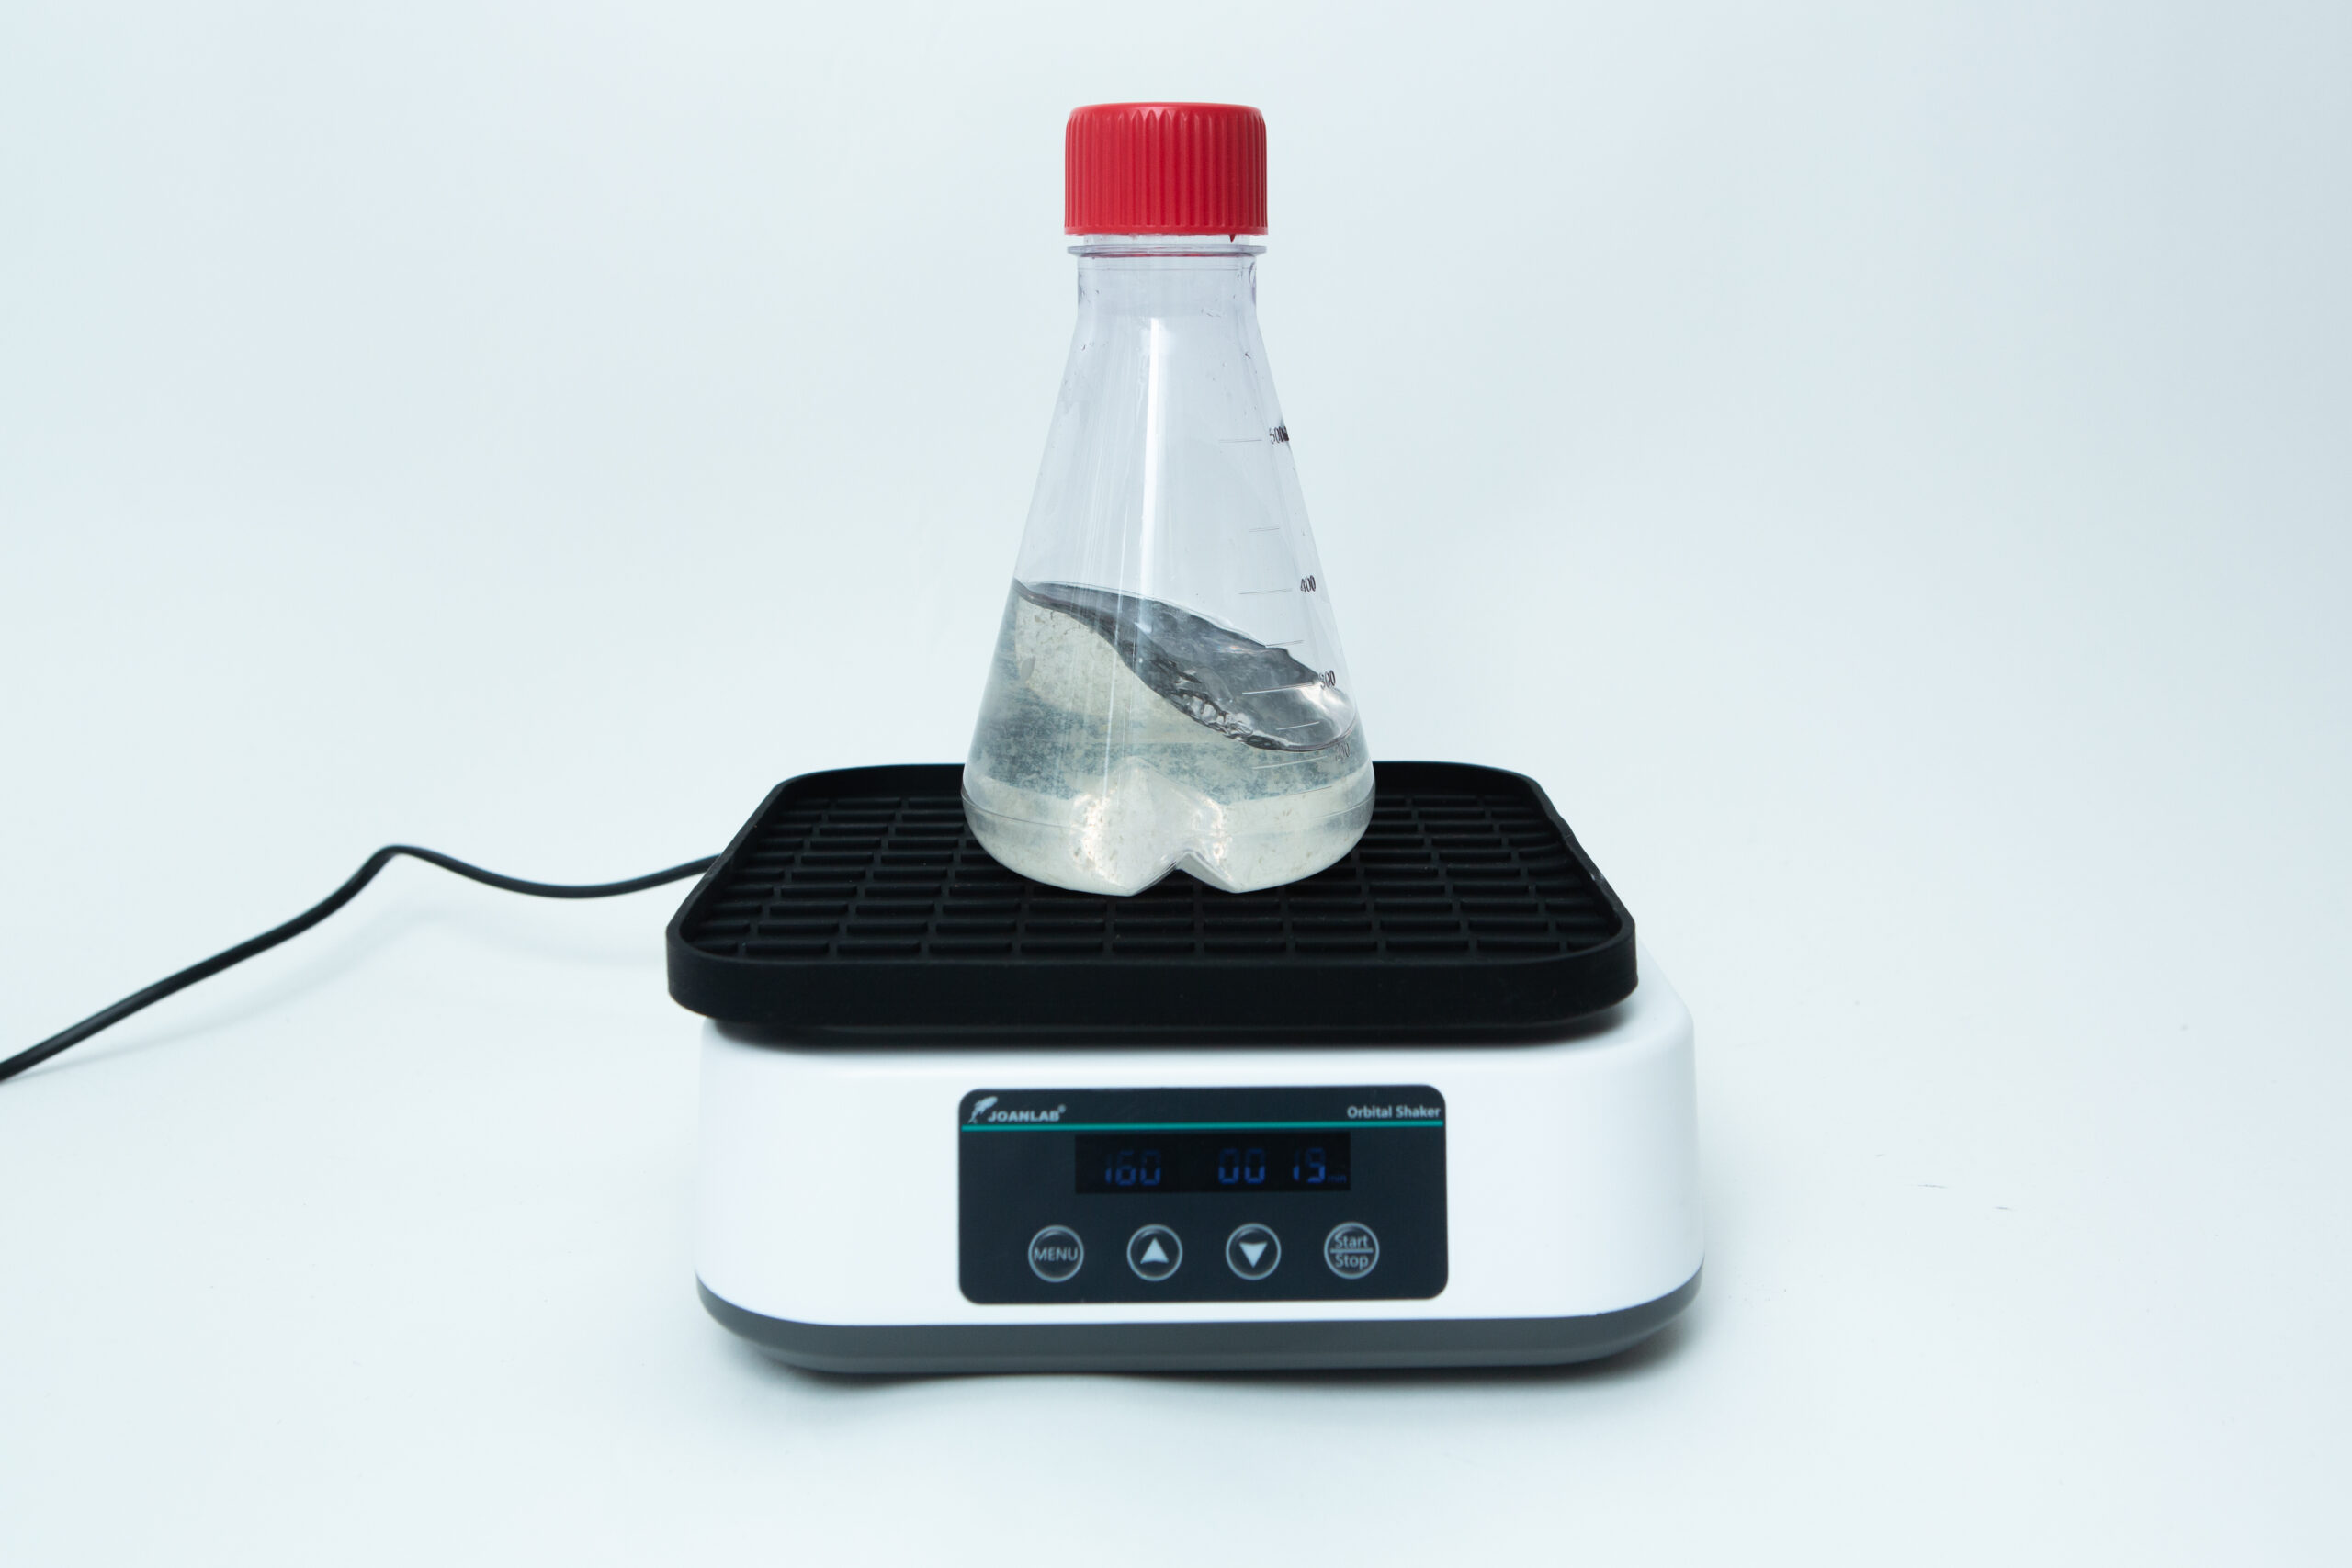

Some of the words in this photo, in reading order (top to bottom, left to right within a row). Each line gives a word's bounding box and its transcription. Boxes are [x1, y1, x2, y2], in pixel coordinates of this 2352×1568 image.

[1300, 575, 1316, 592] 400
[1319, 670, 1336, 690] 300
[1347, 1105, 1392, 1119] Orbital
[1396, 1105, 1441, 1118] Shaker
[1104, 1148, 1161, 1186] 160
[1335, 1233, 1368, 1249] Start
[1034, 1247, 1078, 1261] MENU
[1335, 1253, 1369, 1270] Stop
